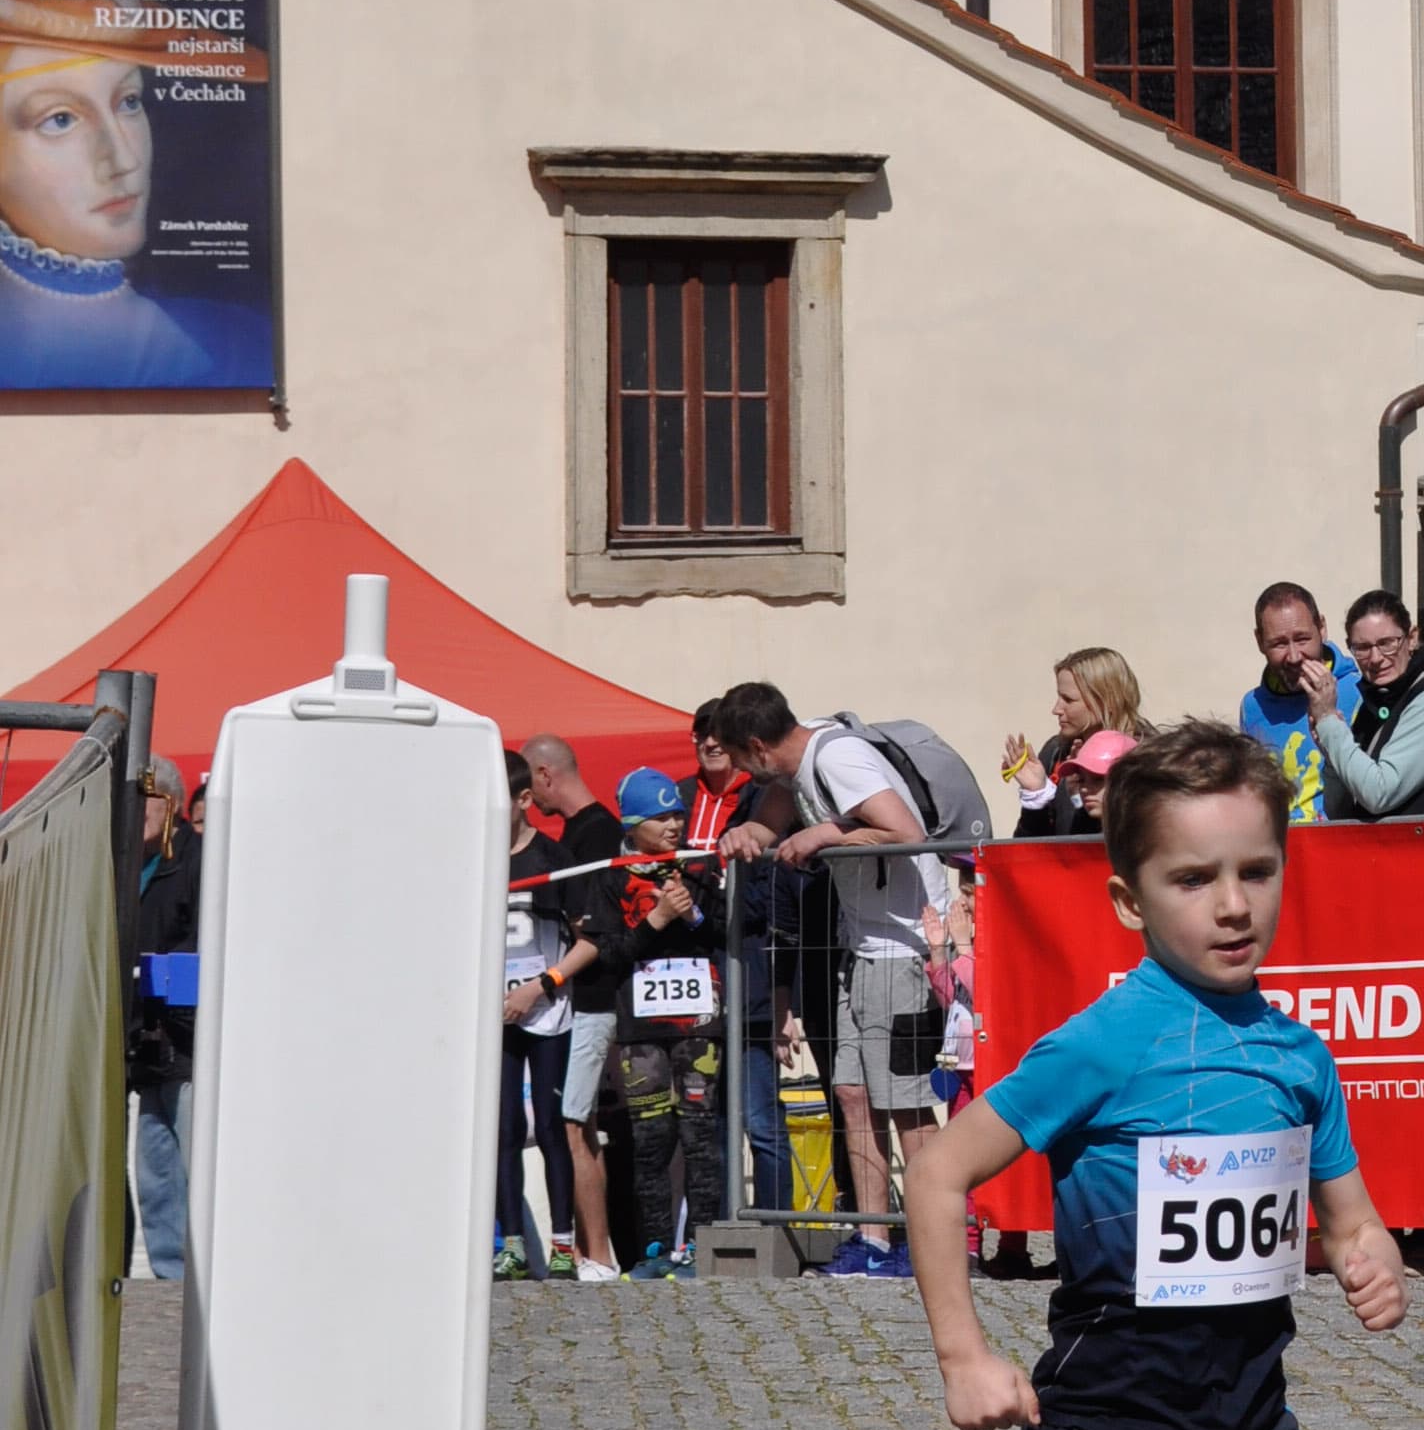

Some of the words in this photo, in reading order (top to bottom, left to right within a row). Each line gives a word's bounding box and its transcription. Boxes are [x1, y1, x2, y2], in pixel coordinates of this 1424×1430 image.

[95, 7, 245, 30] REZIDENCE
[167, 37, 245, 57] nejstarší
[155, 64, 246, 78] renesance
[154, 88, 167, 101] v
[170, 81, 246, 102] Čechách
[644, 979, 701, 1001] 2138
[1241, 1146, 1276, 1163] PVZP
[1158, 1189, 1300, 1264] 5064
[1170, 1284, 1206, 1296] PVZP
